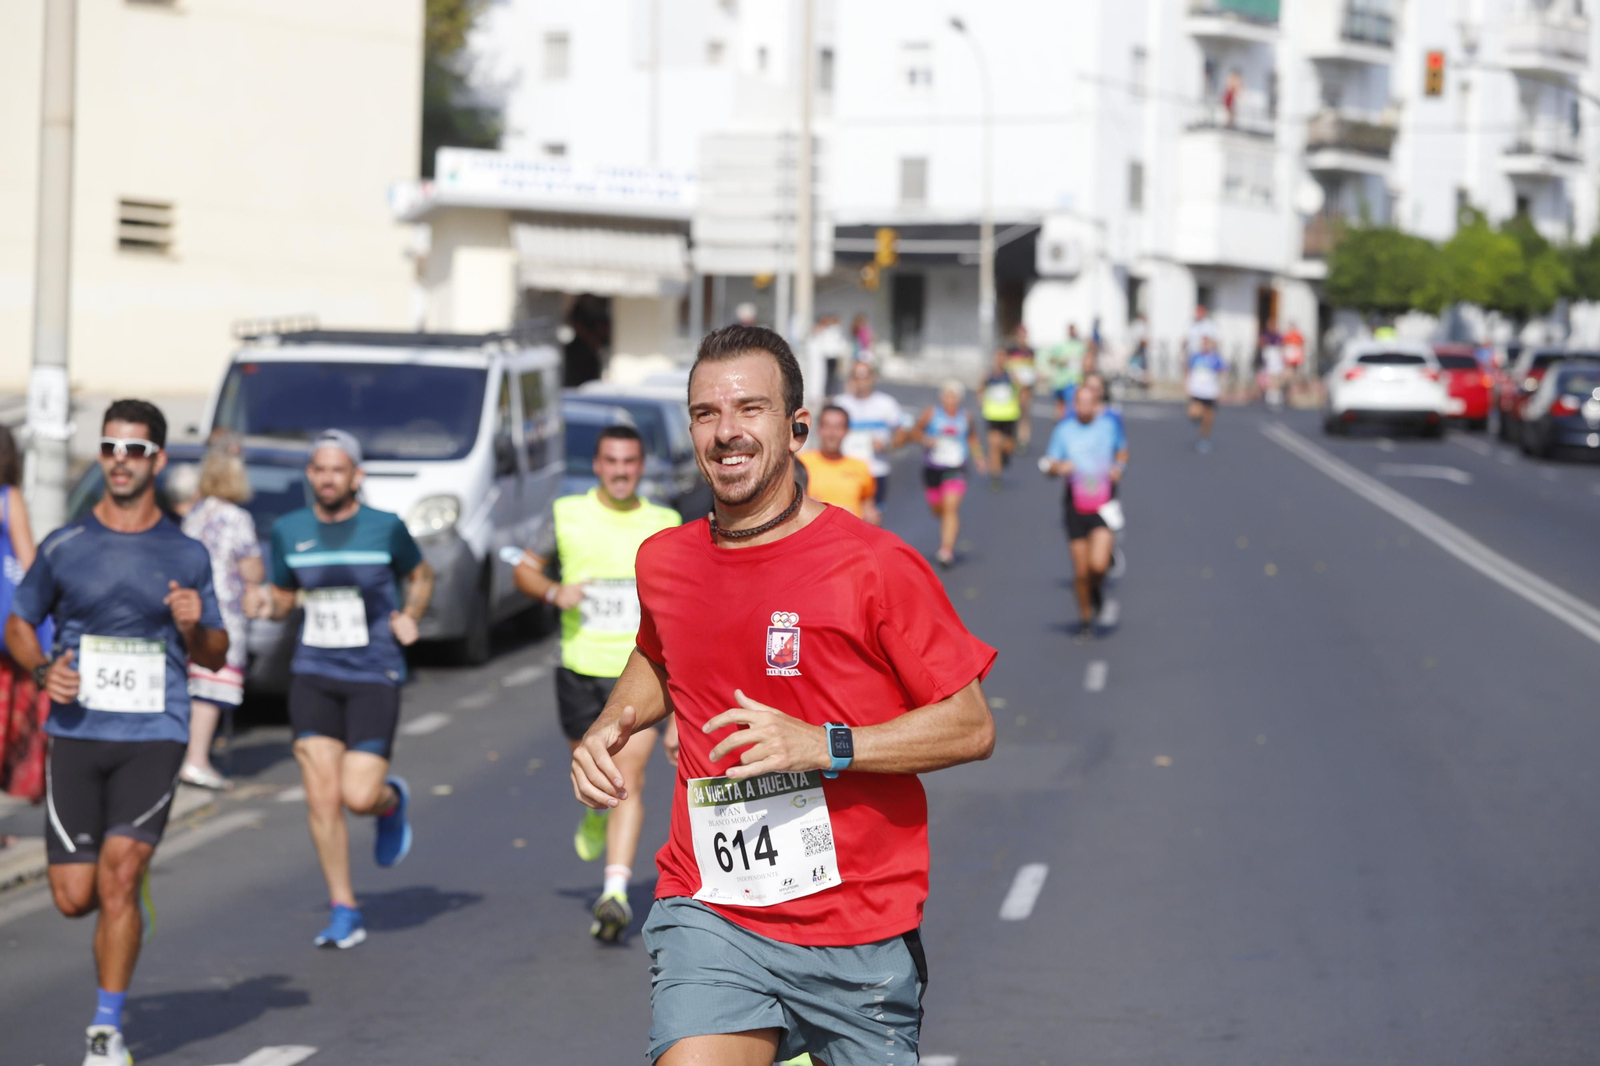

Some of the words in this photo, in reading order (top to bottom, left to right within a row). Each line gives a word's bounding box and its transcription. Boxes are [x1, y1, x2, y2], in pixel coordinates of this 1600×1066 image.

[96, 667, 136, 691] 546
[694, 787, 705, 804] 34
[705, 782, 743, 803] VUELTA
[746, 780, 756, 798] A
[759, 771, 809, 795] HUELVA
[708, 818, 730, 827] BLANCO
[731, 814, 766, 825] MORALES
[713, 825, 779, 873] 614
[736, 871, 780, 882] INDEPENDIENTE
